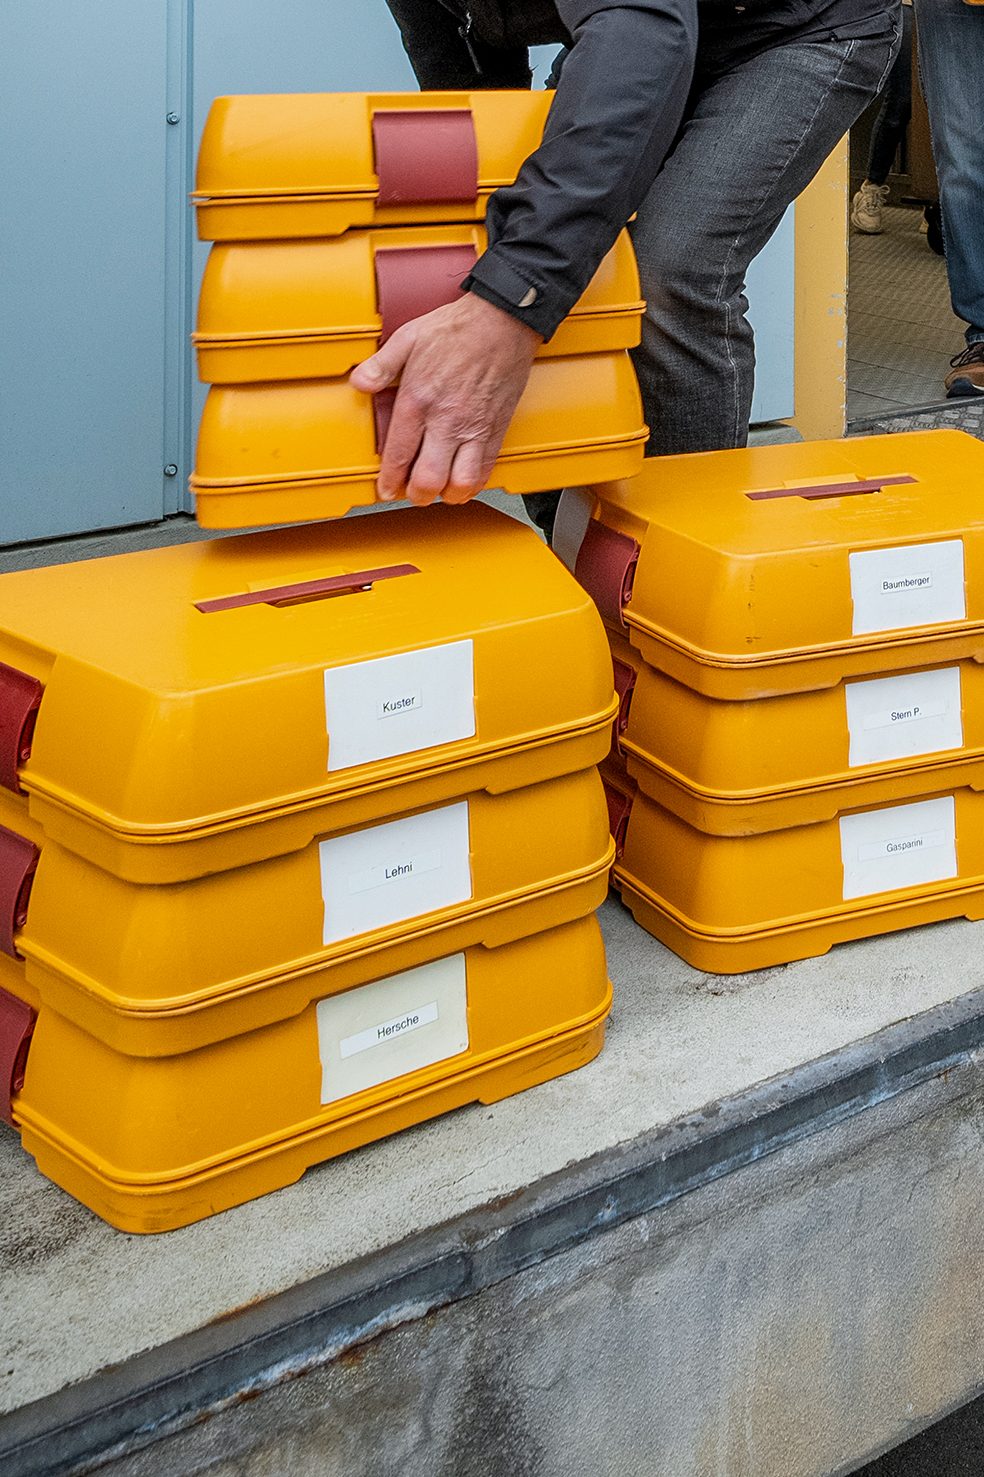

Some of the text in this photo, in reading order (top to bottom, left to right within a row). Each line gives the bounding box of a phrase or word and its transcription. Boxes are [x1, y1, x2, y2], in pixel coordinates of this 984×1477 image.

[882, 576, 930, 590] Baumberger
[382, 696, 416, 713] Kuster
[890, 706, 922, 721] Stern P.
[886, 837, 923, 853] Gasparini
[385, 861, 413, 879] Lehni
[377, 1015, 420, 1039] Hersche
